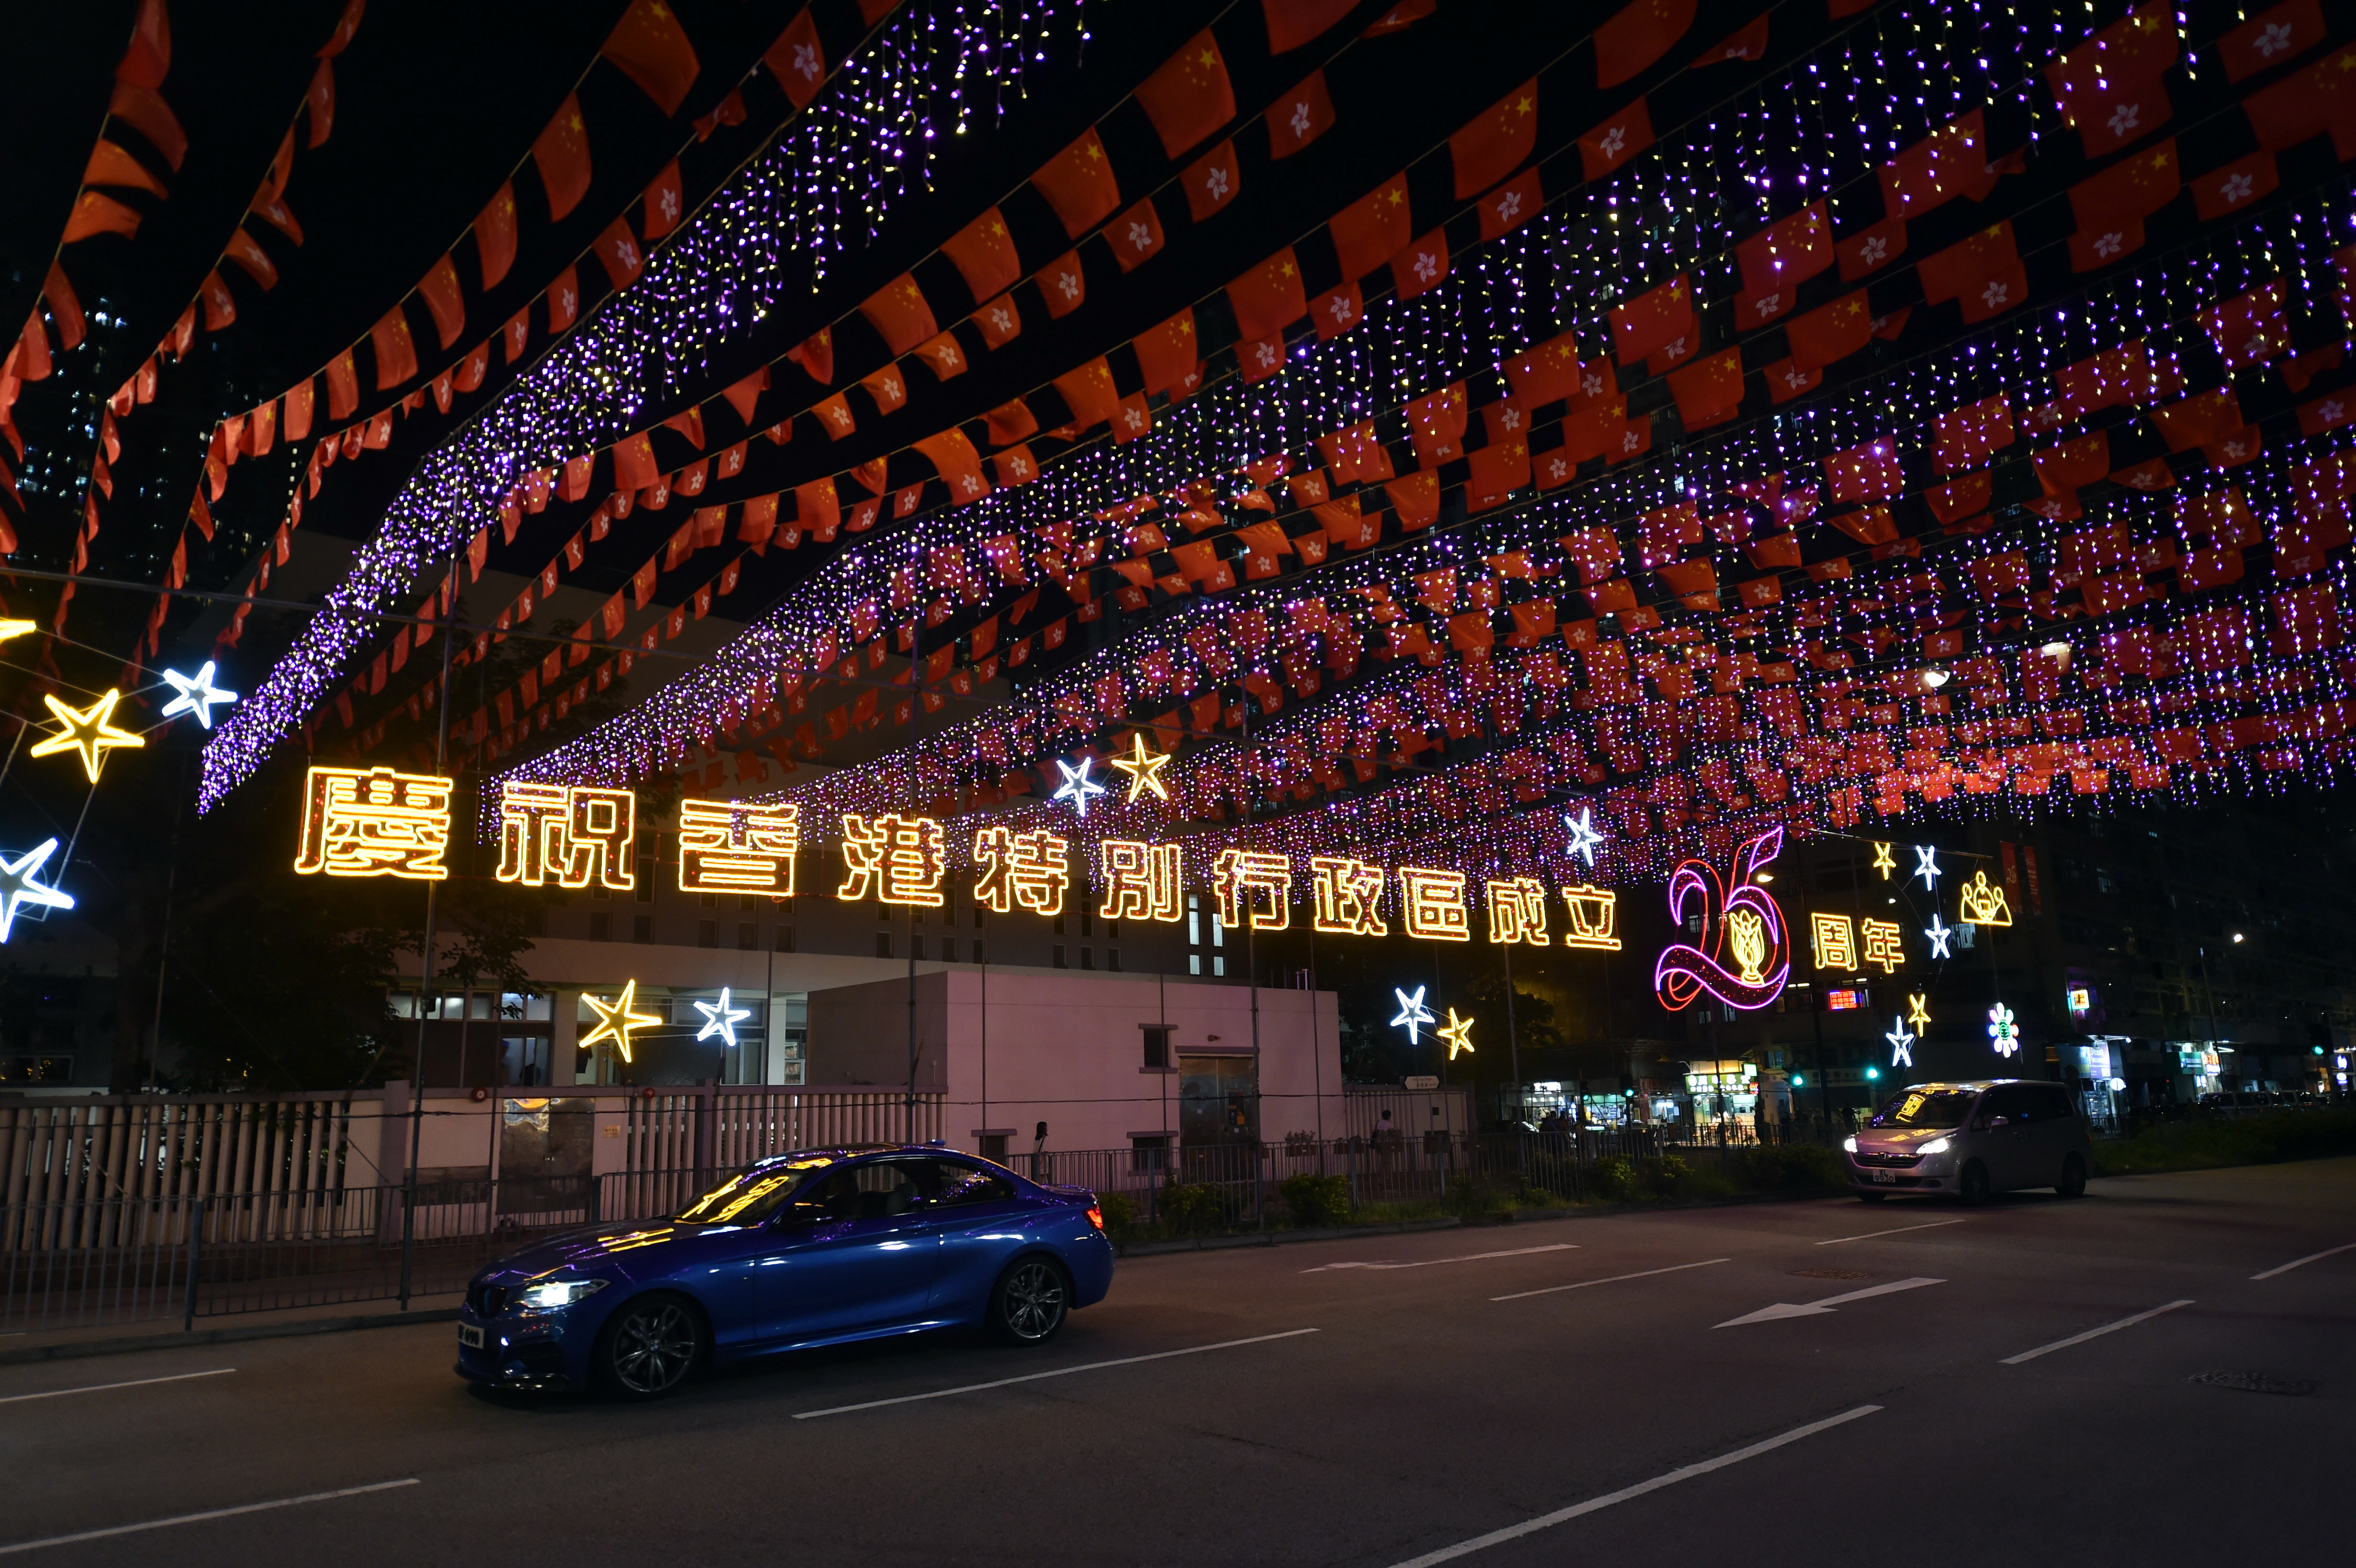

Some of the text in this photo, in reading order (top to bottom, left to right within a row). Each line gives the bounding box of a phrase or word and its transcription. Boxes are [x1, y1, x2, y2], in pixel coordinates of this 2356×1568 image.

[294, 766, 1623, 952] 慶祝香港特別行政區成立
[1811, 912, 1905, 974] 周年
